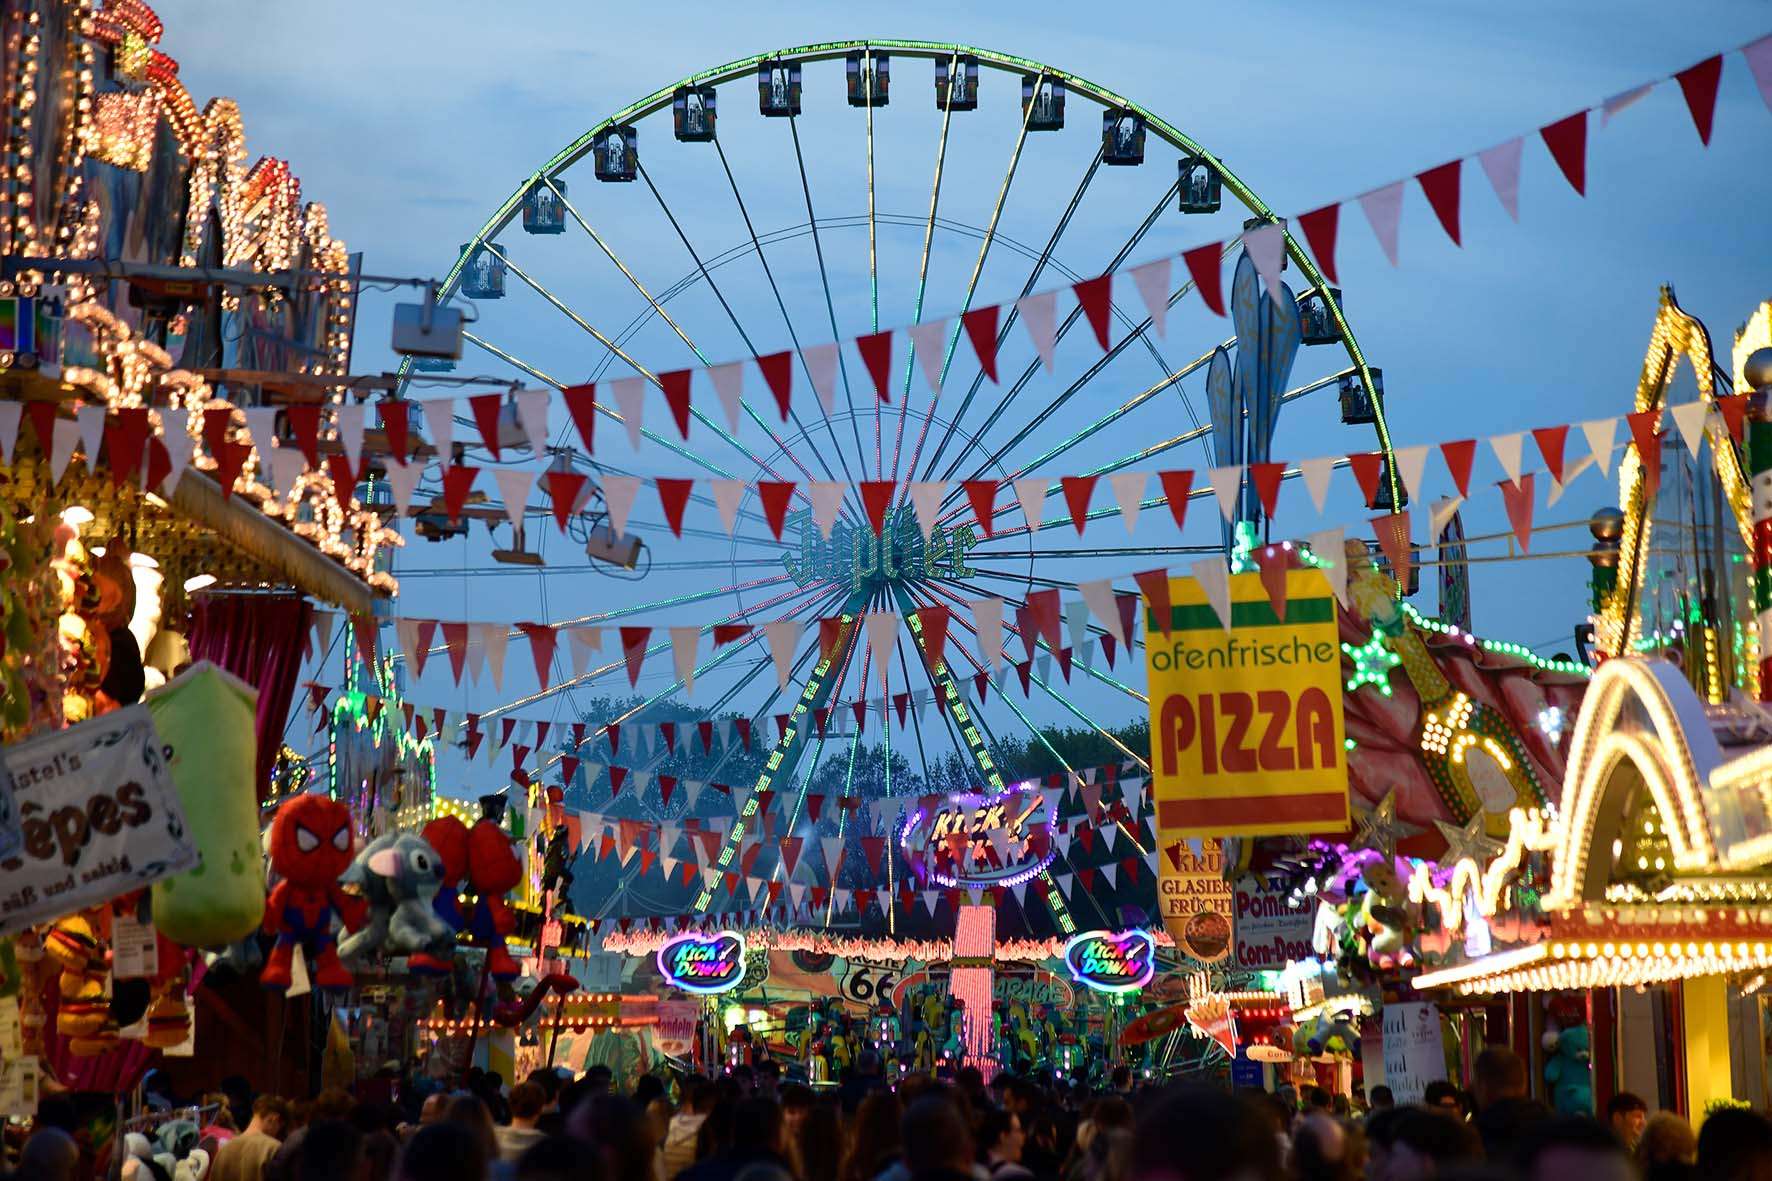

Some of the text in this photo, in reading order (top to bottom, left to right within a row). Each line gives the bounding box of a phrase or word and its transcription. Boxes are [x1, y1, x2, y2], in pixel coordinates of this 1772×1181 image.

[1152, 635, 1334, 673] ofenfrische
[1160, 687, 1338, 777] PIZZA
[18, 782, 152, 866] êpes
[674, 943, 724, 962] KICK
[1082, 941, 1132, 959] KICK
[673, 960, 735, 978] DOWN
[1081, 958, 1143, 977] DOWN
[850, 967, 895, 1000] 66
[994, 976, 1065, 1004] ARAGE
